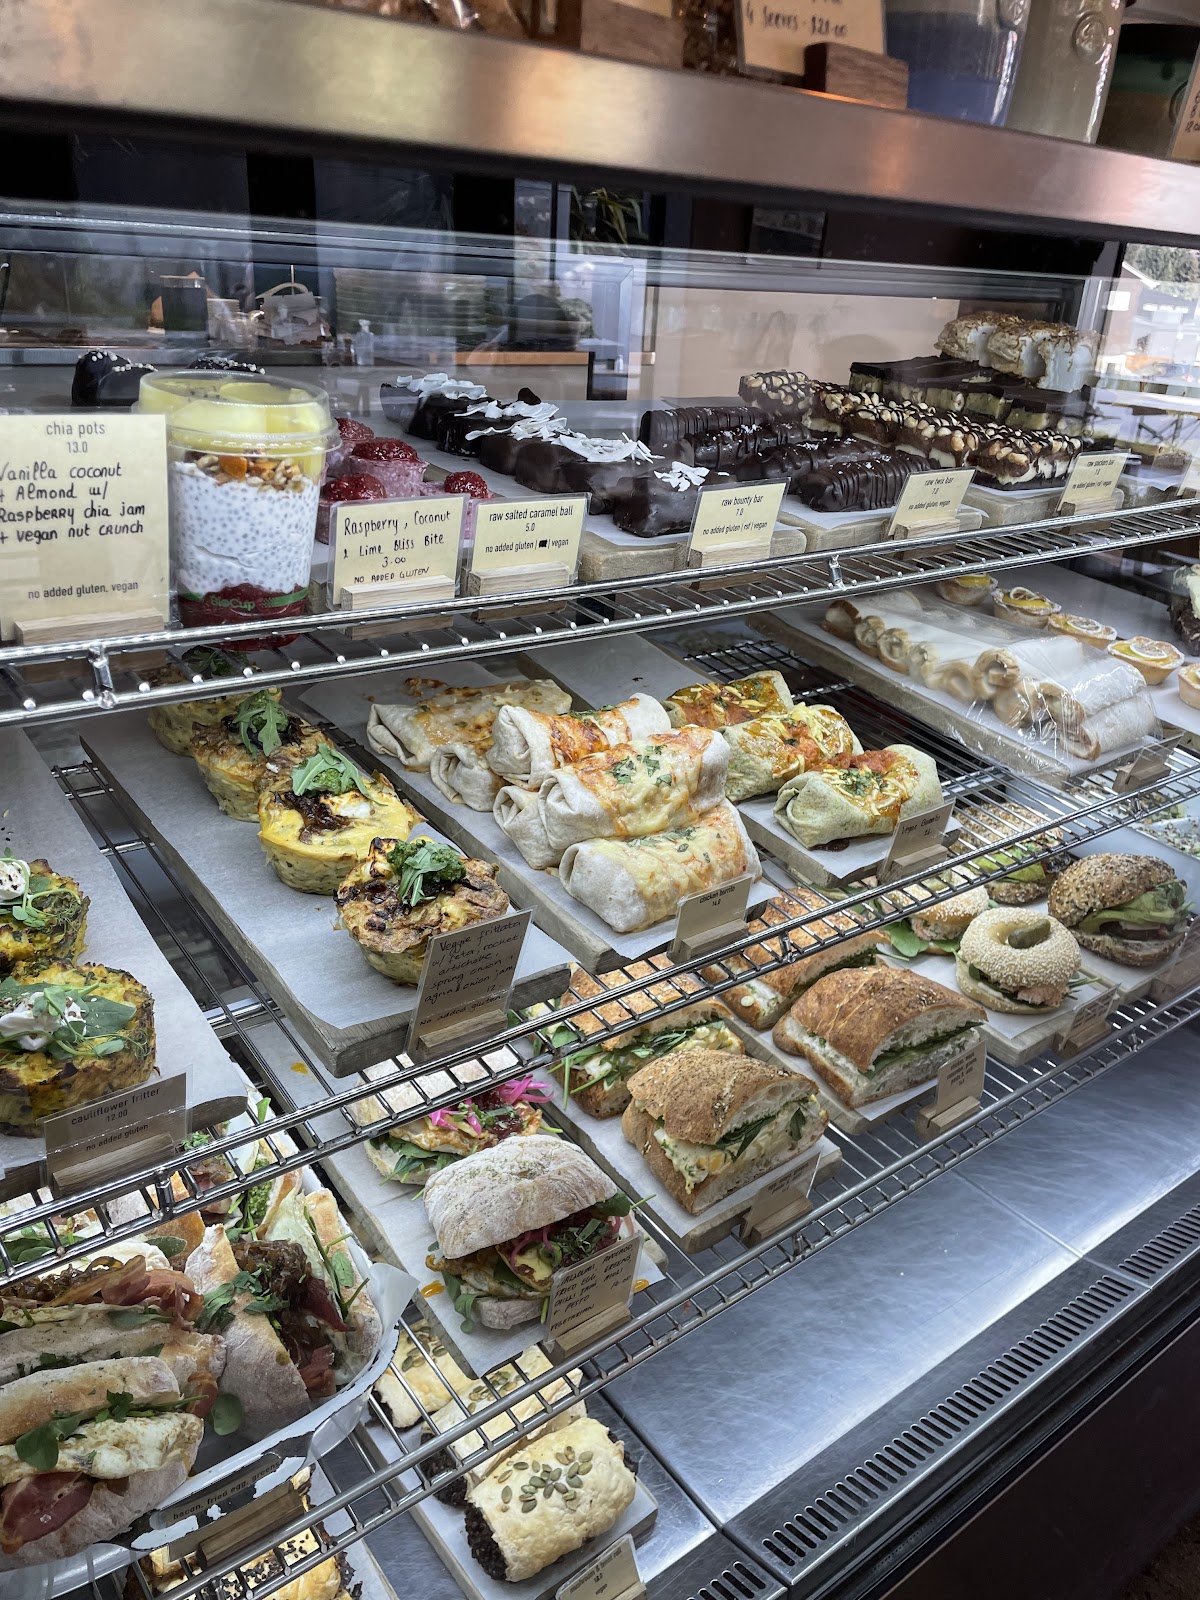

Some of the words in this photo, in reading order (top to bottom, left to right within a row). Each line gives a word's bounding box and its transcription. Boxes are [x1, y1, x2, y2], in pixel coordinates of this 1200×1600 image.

[46, 422, 73, 436] chia
[78, 422, 106, 438] pots
[66, 441, 88, 453] 13.0
[69, 462, 122, 479] coconut
[16, 482, 77, 500] Almond
[84, 499, 111, 519] chia
[119, 501, 145, 517] jam
[721, 498, 732, 507] raw
[733, 496, 753, 506] bounty
[753, 494, 764, 504] bar
[414, 510, 451, 526] Coconut
[489, 512, 504, 522] raw
[505, 508, 528, 521] salted
[529, 506, 558, 519] caramel
[559, 505, 573, 516] ball
[16, 529, 58, 544] vegan
[68, 523, 91, 538] nut
[525, 522, 536, 532] 5.0
[709, 525, 725, 535] added
[725, 524, 740, 534] gluten
[753, 521, 768, 530] vegan
[359, 545, 384, 557] Lime
[424, 533, 445, 547] Bite
[494, 542, 514, 552] added
[515, 541, 534, 552] gluten
[551, 538, 569, 548] vegan
[382, 556, 407, 568] 3.00
[354, 575, 365, 584] NO
[371, 572, 395, 582] ADDED
[400, 566, 430, 579] GLUTEN
[28, 590, 40, 599] no
[43, 586, 73, 598] added
[111, 581, 139, 594] vegan
[699, 892, 719, 904] chicken
[720, 885, 736, 896] burrito
[440, 935, 472, 956] Veggie
[477, 920, 521, 946] frittata
[430, 973, 465, 991] spring
[469, 959, 502, 976] onion
[495, 966, 514, 981] jam
[419, 1018, 432, 1027] No
[437, 1006, 467, 1021] added
[71, 1099, 128, 1125] cauliflower
[132, 1086, 161, 1104] fritter
[106, 1109, 128, 1123] 12.00
[85, 1143, 96, 1151] no
[98, 1133, 123, 1148] added
[124, 1123, 149, 1139] gluten
[564, 1295, 589, 1312] PESTO
[173, 1501, 203, 1520] bacon,
[207, 1489, 229, 1505] fried
[230, 1480, 250, 1496] egg,
